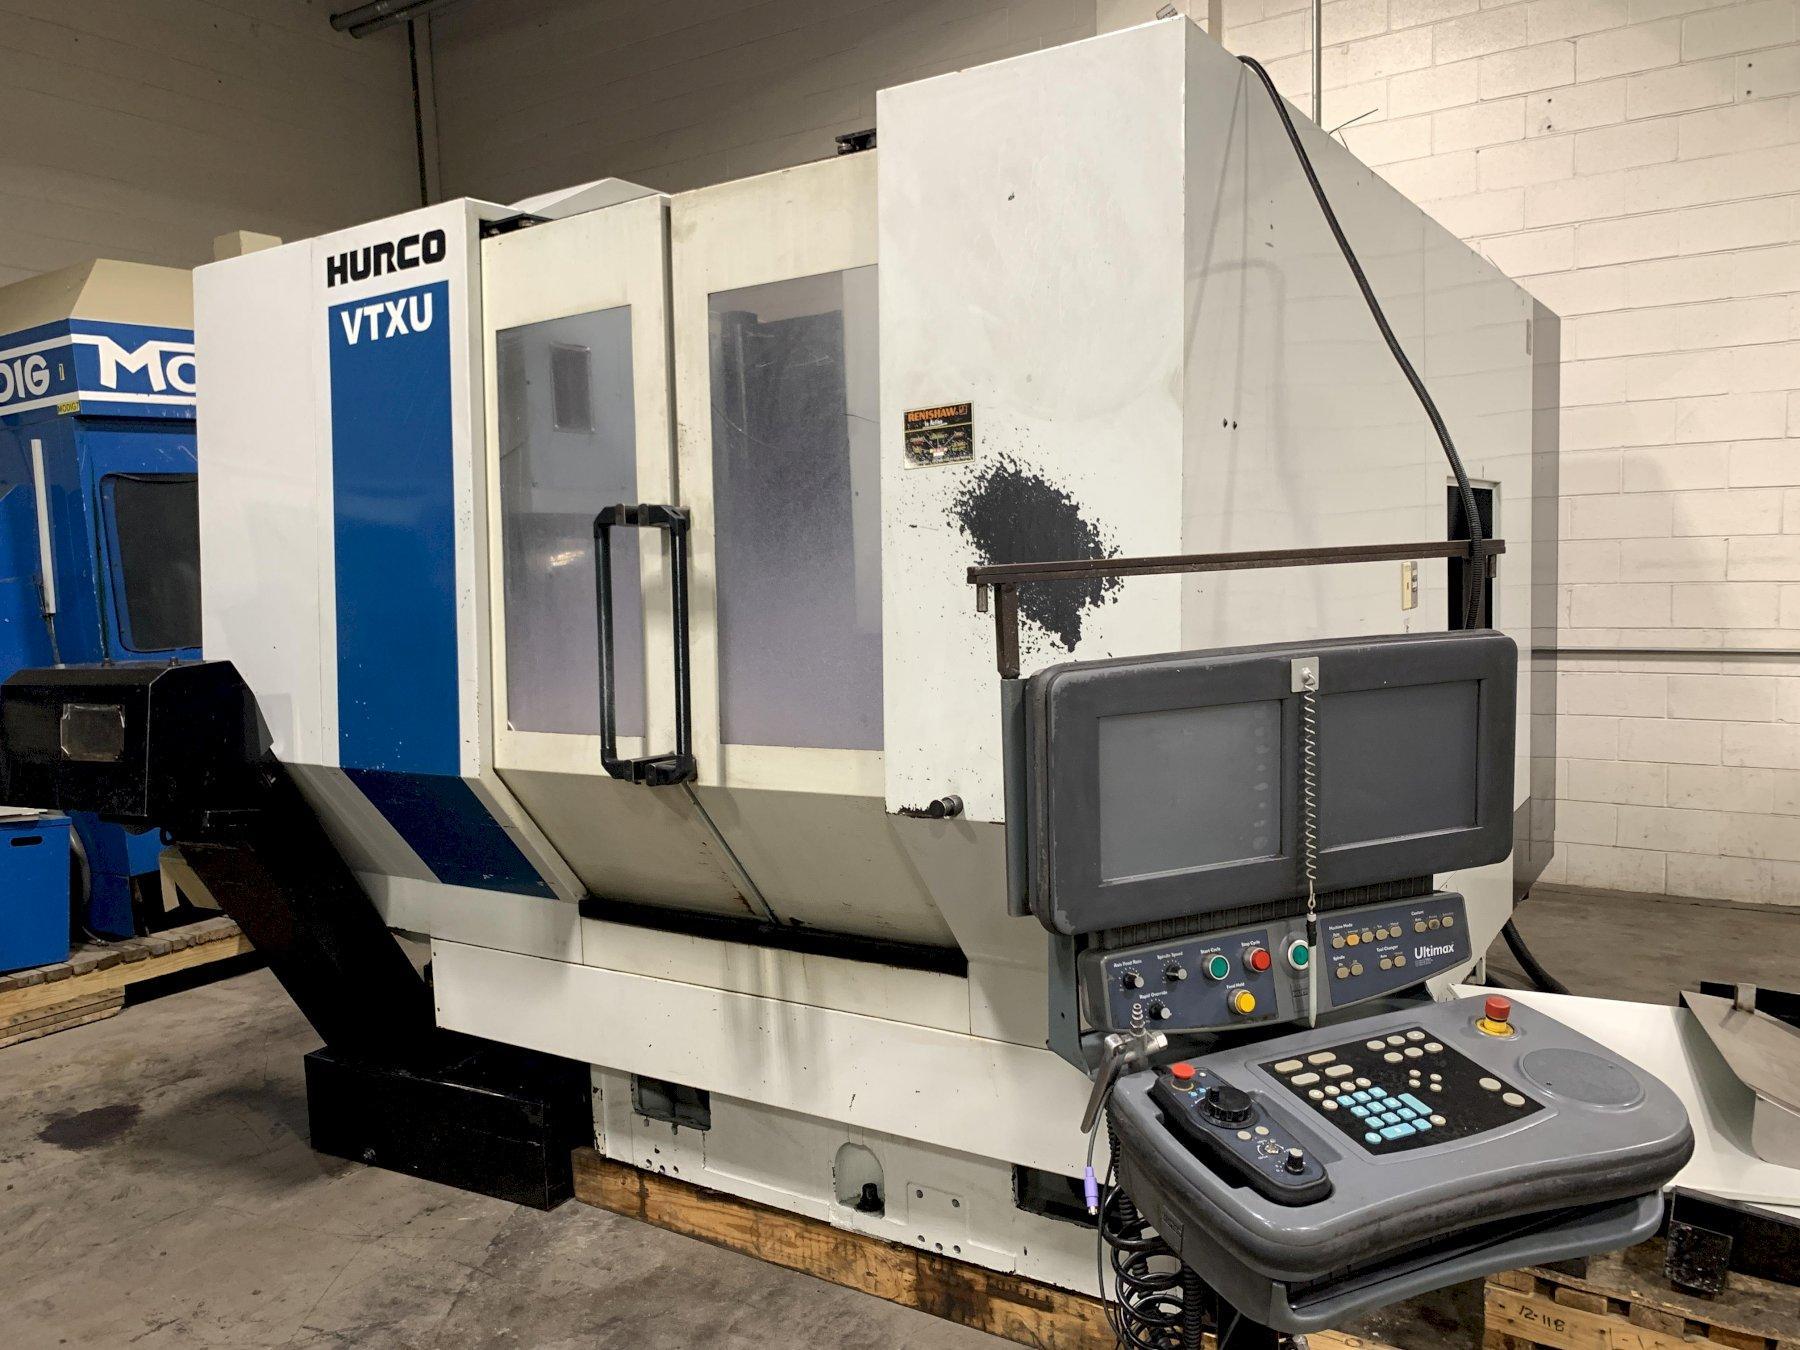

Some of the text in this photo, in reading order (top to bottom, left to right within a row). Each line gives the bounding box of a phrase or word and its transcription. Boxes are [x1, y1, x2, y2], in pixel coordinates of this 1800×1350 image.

[327, 229, 446, 288] HURCO
[341, 292, 433, 346] VTXU
[907, 407, 957, 421] RENISHAW
[1414, 942, 1454, 960] Ultimax
[1151, 990, 1168, 998] Override
[1519, 1305, 1566, 1333] 12-118
